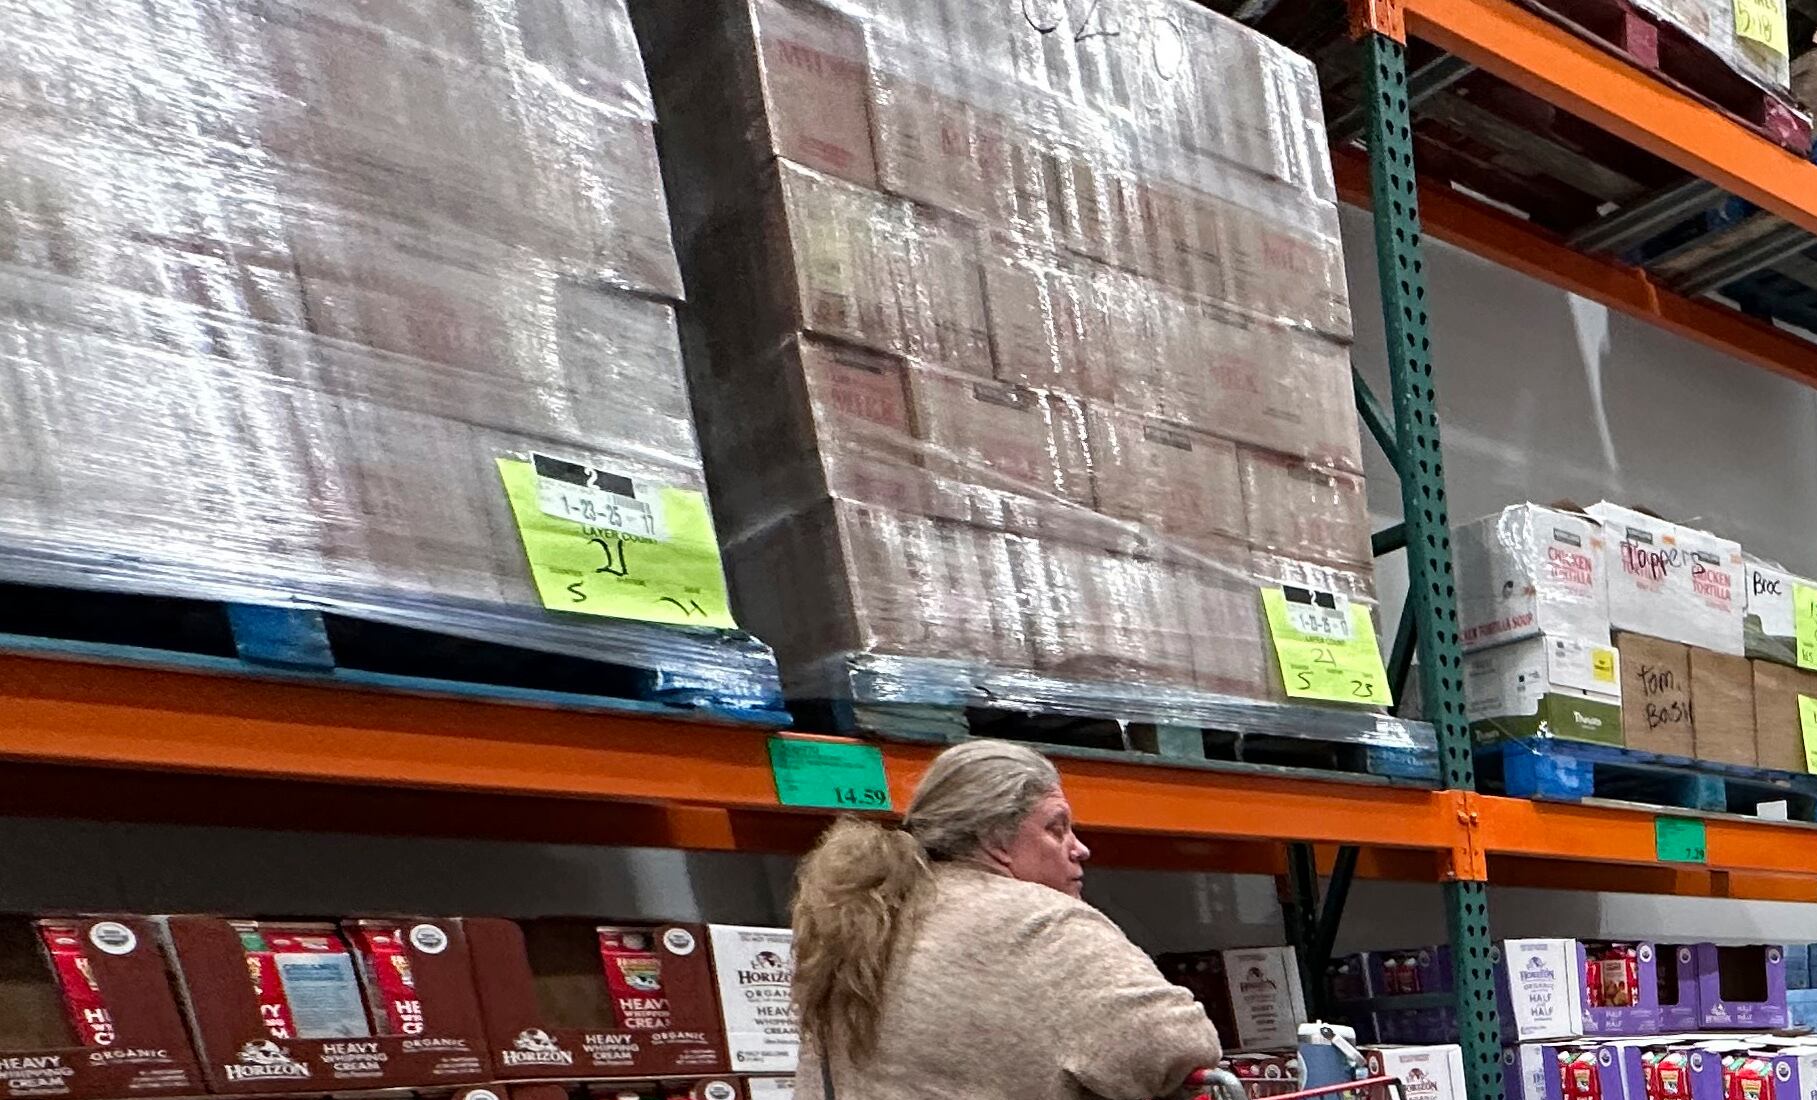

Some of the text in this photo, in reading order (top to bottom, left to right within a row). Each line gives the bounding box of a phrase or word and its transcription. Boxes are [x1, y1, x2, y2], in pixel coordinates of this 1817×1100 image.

[584, 467, 597, 487] 2
[1693, 580, 1731, 601] TORTILLA
[834, 787, 887, 806] 14.59
[1529, 993, 1552, 1002] HALF
[1531, 1006, 1553, 1016] HALF
[585, 1034, 632, 1044] HEAVY
[651, 1032, 705, 1041] ORGANIC
[323, 1043, 378, 1054] HEAVY
[402, 1039, 467, 1048] ORGANIC
[583, 1044, 639, 1053] WHIPPING
[89, 1049, 168, 1061] ORGANIC
[502, 1049, 574, 1065] HORIZON
[592, 1051, 632, 1060] CREAM
[737, 1051, 745, 1062] 6
[224, 1062, 312, 1081] HORIZON
[333, 1062, 380, 1071] CREAM
